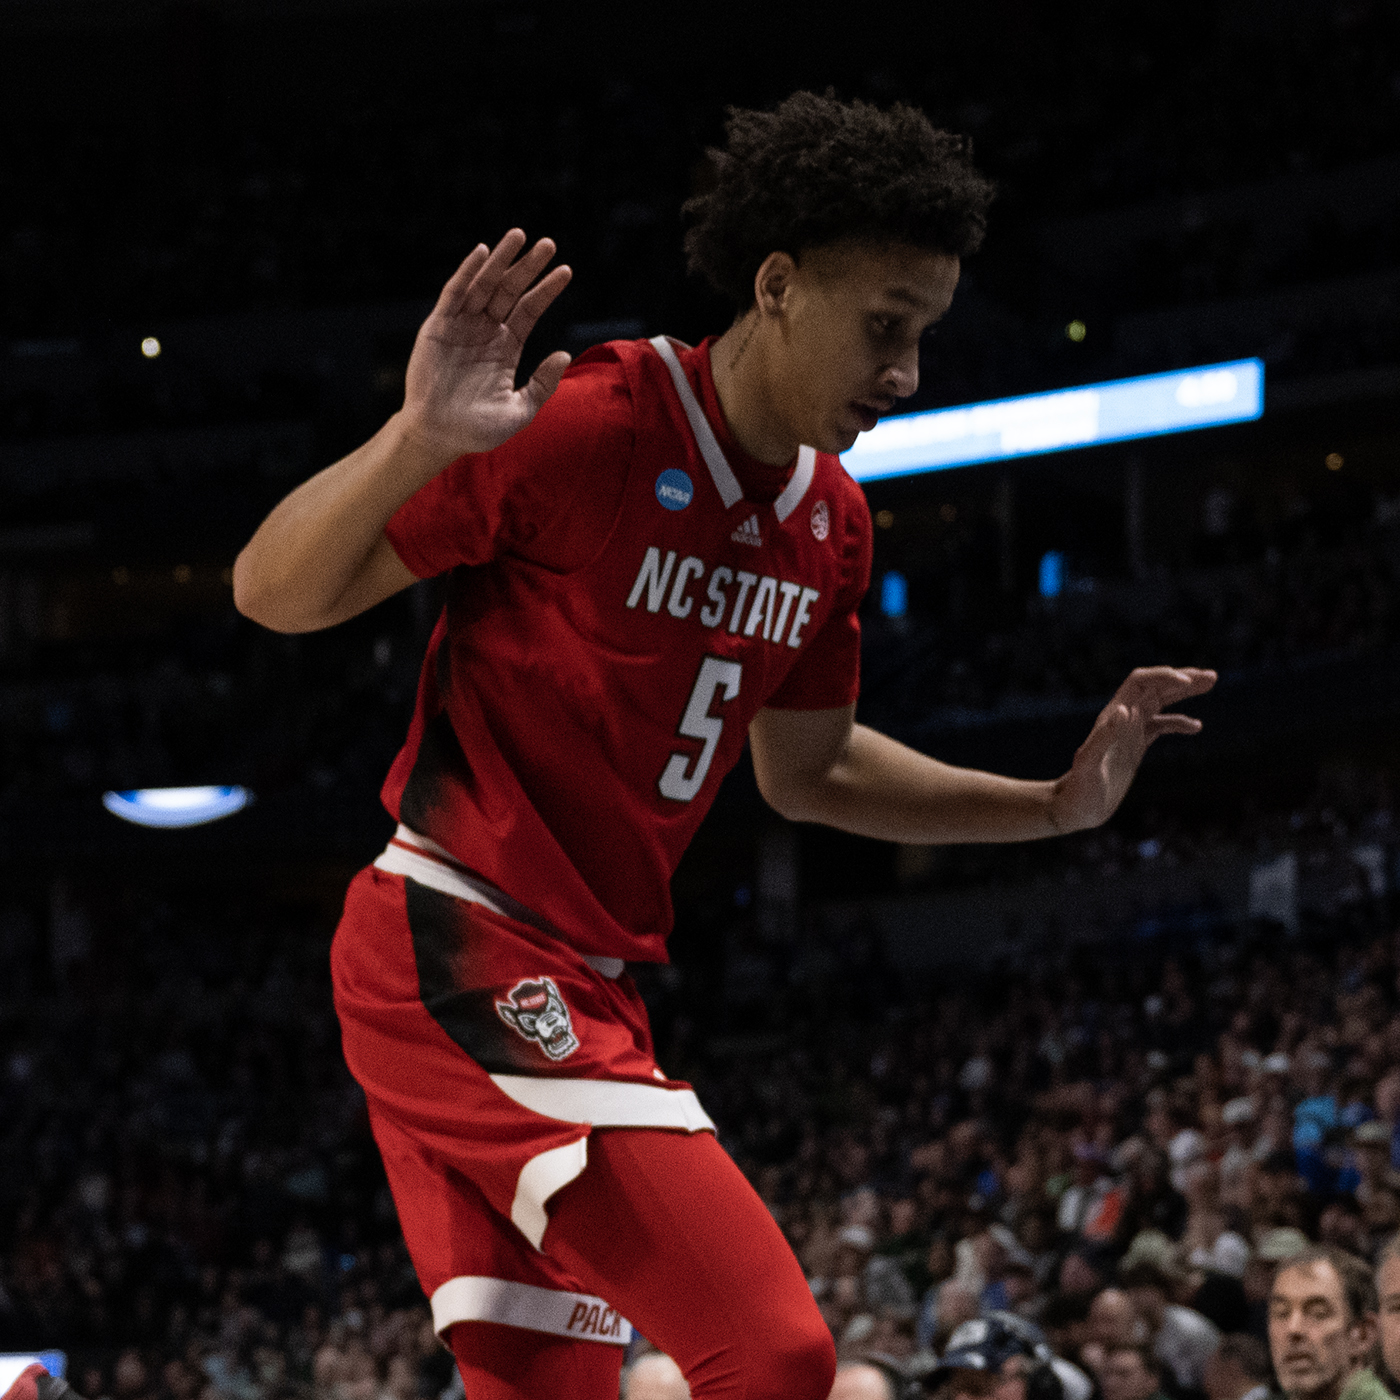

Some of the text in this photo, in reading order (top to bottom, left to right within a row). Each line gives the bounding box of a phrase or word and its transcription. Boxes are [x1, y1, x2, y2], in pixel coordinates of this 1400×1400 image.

[626, 546, 821, 649] NC STATE
[659, 655, 742, 803] 5
[566, 1301, 621, 1338] PACK
